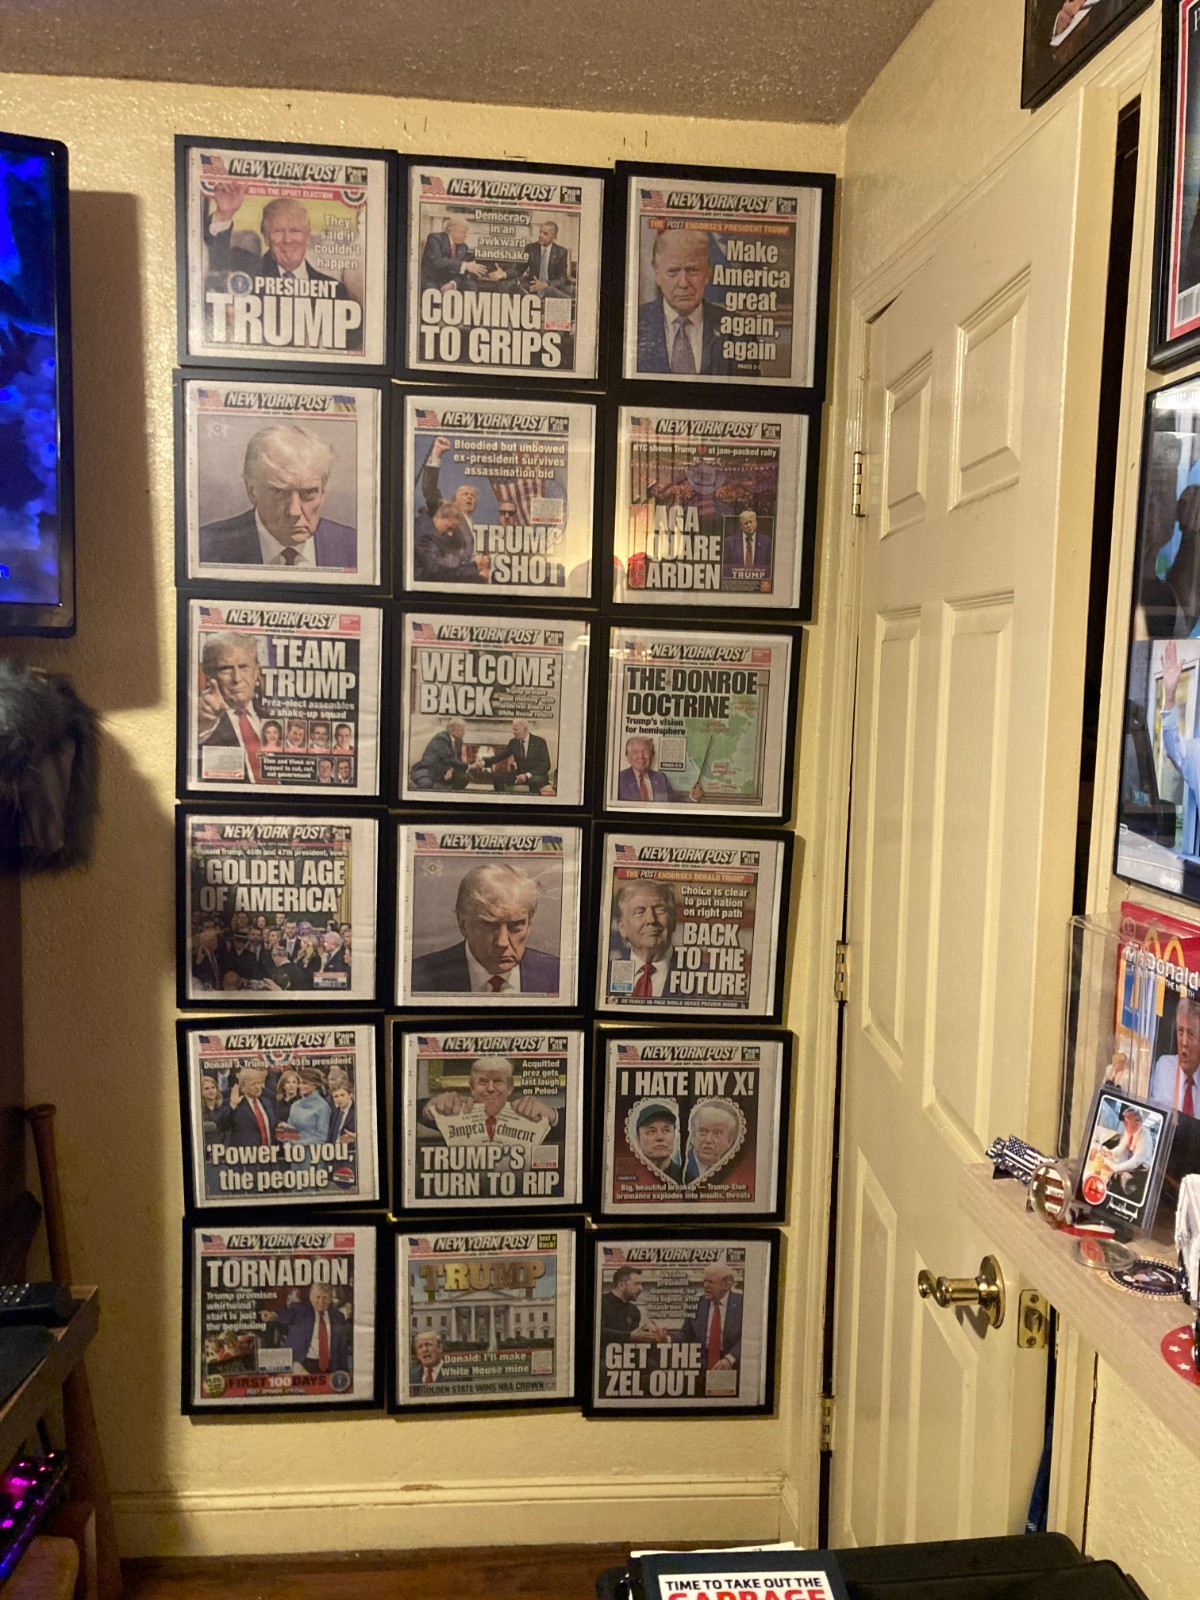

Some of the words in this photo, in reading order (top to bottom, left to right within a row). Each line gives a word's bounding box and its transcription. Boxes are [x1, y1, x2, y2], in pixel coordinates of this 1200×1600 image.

[228, 158, 262, 178] NEW
[261, 161, 304, 181] YORK
[303, 164, 341, 184] POST
[447, 178, 482, 197] NEW
[481, 180, 522, 200] YORK
[520, 183, 557, 203] POST
[666, 191, 701, 208] NEW
[700, 192, 740, 212] YORK
[738, 196, 774, 213] POST
[325, 214, 351, 229] They
[475, 209, 531, 224] Democracy
[320, 230, 343, 242] said
[345, 230, 355, 241] it
[490, 223, 500, 233] in
[502, 225, 515, 234] an
[314, 243, 361, 258] couldn't
[479, 236, 526, 248] awkward
[727, 240, 779, 263] Make
[316, 256, 358, 271] happen
[474, 248, 530, 260] handshake
[712, 264, 790, 288] America
[255, 277, 339, 299] PRESIDENT
[421, 288, 541, 330] COMING
[725, 290, 778, 312] great
[205, 292, 362, 349] TRUMP
[720, 315, 779, 338] again,
[421, 324, 462, 362] TO
[468, 328, 562, 368] GRIPS
[722, 340, 776, 361] again
[224, 391, 259, 408] NEW
[258, 392, 297, 410] YORK
[296, 394, 333, 412] POST
[440, 410, 474, 428] NEW
[473, 412, 512, 430] YORK
[510, 414, 546, 432] POST
[656, 418, 688, 436] NEW
[687, 420, 726, 438] YORK
[724, 422, 760, 439] POST
[454, 440, 498, 451] Bloodied
[500, 442, 517, 452] but
[519, 442, 565, 454] unbowed
[454, 453, 519, 465] ex-president
[521, 456, 565, 467] survives
[464, 466, 535, 478] assassination
[538, 469, 554, 479] bid
[472, 524, 562, 555] TRUMP
[632, 534, 721, 563] QUARE
[494, 553, 565, 585] SHOT
[628, 561, 721, 590] GARDEN
[731, 572, 766, 580] TRUMP
[227, 608, 262, 626] NEW
[261, 610, 299, 628] YORK
[298, 612, 336, 630] POST
[438, 624, 472, 641] NEW
[471, 626, 508, 643] YORK
[506, 628, 541, 645] POST
[272, 638, 347, 670] TEAM
[651, 644, 682, 660] NEW
[680, 644, 716, 661] YORK
[714, 646, 750, 663] POST
[420, 651, 555, 689] WELCOME
[626, 666, 667, 692] THE
[672, 668, 758, 695] DONROE
[261, 667, 357, 700] TRUMP
[420, 682, 496, 717] BACK
[626, 692, 730, 719] DOCTRINE
[625, 716, 658, 728] Trump's
[660, 718, 684, 728] vision
[625, 725, 637, 735] for
[638, 726, 686, 738] hemisphere
[223, 824, 256, 839] NEW
[255, 825, 292, 840] YORK
[292, 826, 326, 840] POST
[440, 834, 474, 850] NEW
[473, 834, 508, 850] YORK
[506, 836, 542, 851] POST
[639, 845, 673, 862] NEW
[672, 846, 706, 864] YORK
[704, 849, 738, 865] POST
[302, 859, 346, 884] AGE
[200, 886, 229, 912] OF
[680, 884, 712, 896] Choice
[714, 886, 722, 896] is
[724, 887, 748, 897] clear
[684, 897, 694, 906] to
[696, 898, 712, 908] put
[714, 899, 744, 908] nation
[684, 908, 696, 917] on
[697, 907, 721, 920] right
[722, 908, 744, 919] path
[684, 922, 740, 947] BACK
[674, 946, 702, 970] TO
[707, 948, 744, 972] THE
[670, 972, 746, 996] FUTURE
[225, 1034, 260, 1052] NEW
[259, 1032, 297, 1050] YORK
[295, 1031, 332, 1048] POST
[442, 1036, 476, 1053] NEW
[475, 1036, 511, 1053] YORK
[508, 1036, 546, 1052] POST
[522, 1060, 560, 1070] Acquitted
[641, 1046, 674, 1062] NEW
[673, 1046, 707, 1062] YORK
[704, 1046, 738, 1062] POST
[522, 1071, 540, 1080] prez
[542, 1070, 560, 1079] gets
[522, 1077, 537, 1086] last
[537, 1078, 560, 1089] laugh
[621, 1070, 629, 1096] I
[635, 1070, 690, 1096] HATE
[694, 1071, 729, 1096] MY
[732, 1071, 756, 1096] X!
[522, 1087, 533, 1096] on
[534, 1086, 558, 1096] Pelosi
[282, 1141, 306, 1163] to
[310, 1142, 354, 1164] you,
[420, 1145, 526, 1171] TRUMP'S
[220, 1168, 255, 1192] the
[420, 1172, 480, 1197] TURN
[487, 1172, 516, 1196] TO
[522, 1172, 560, 1196] RIP
[228, 1234, 261, 1250] NEW
[260, 1233, 297, 1250] YORK
[296, 1232, 332, 1248] POST
[433, 1236, 466, 1252] NEW
[464, 1236, 501, 1252] YORK
[500, 1234, 536, 1250] POST
[626, 1248, 661, 1263] NEW
[660, 1248, 694, 1263] YORK
[690, 1248, 726, 1263] POST
[206, 1258, 348, 1288] TORNADON
[420, 1261, 546, 1293] TRUMP
[605, 1342, 652, 1370] GET
[656, 1342, 702, 1370] THE
[605, 1370, 644, 1397] ZEL
[648, 1370, 700, 1397] OUT
[664, 1580, 702, 1591] TIME
[702, 1579, 723, 1590] TO
[724, 1578, 762, 1590] TAKE
[764, 1578, 792, 1588] OUT
[794, 1578, 823, 1588] THE
